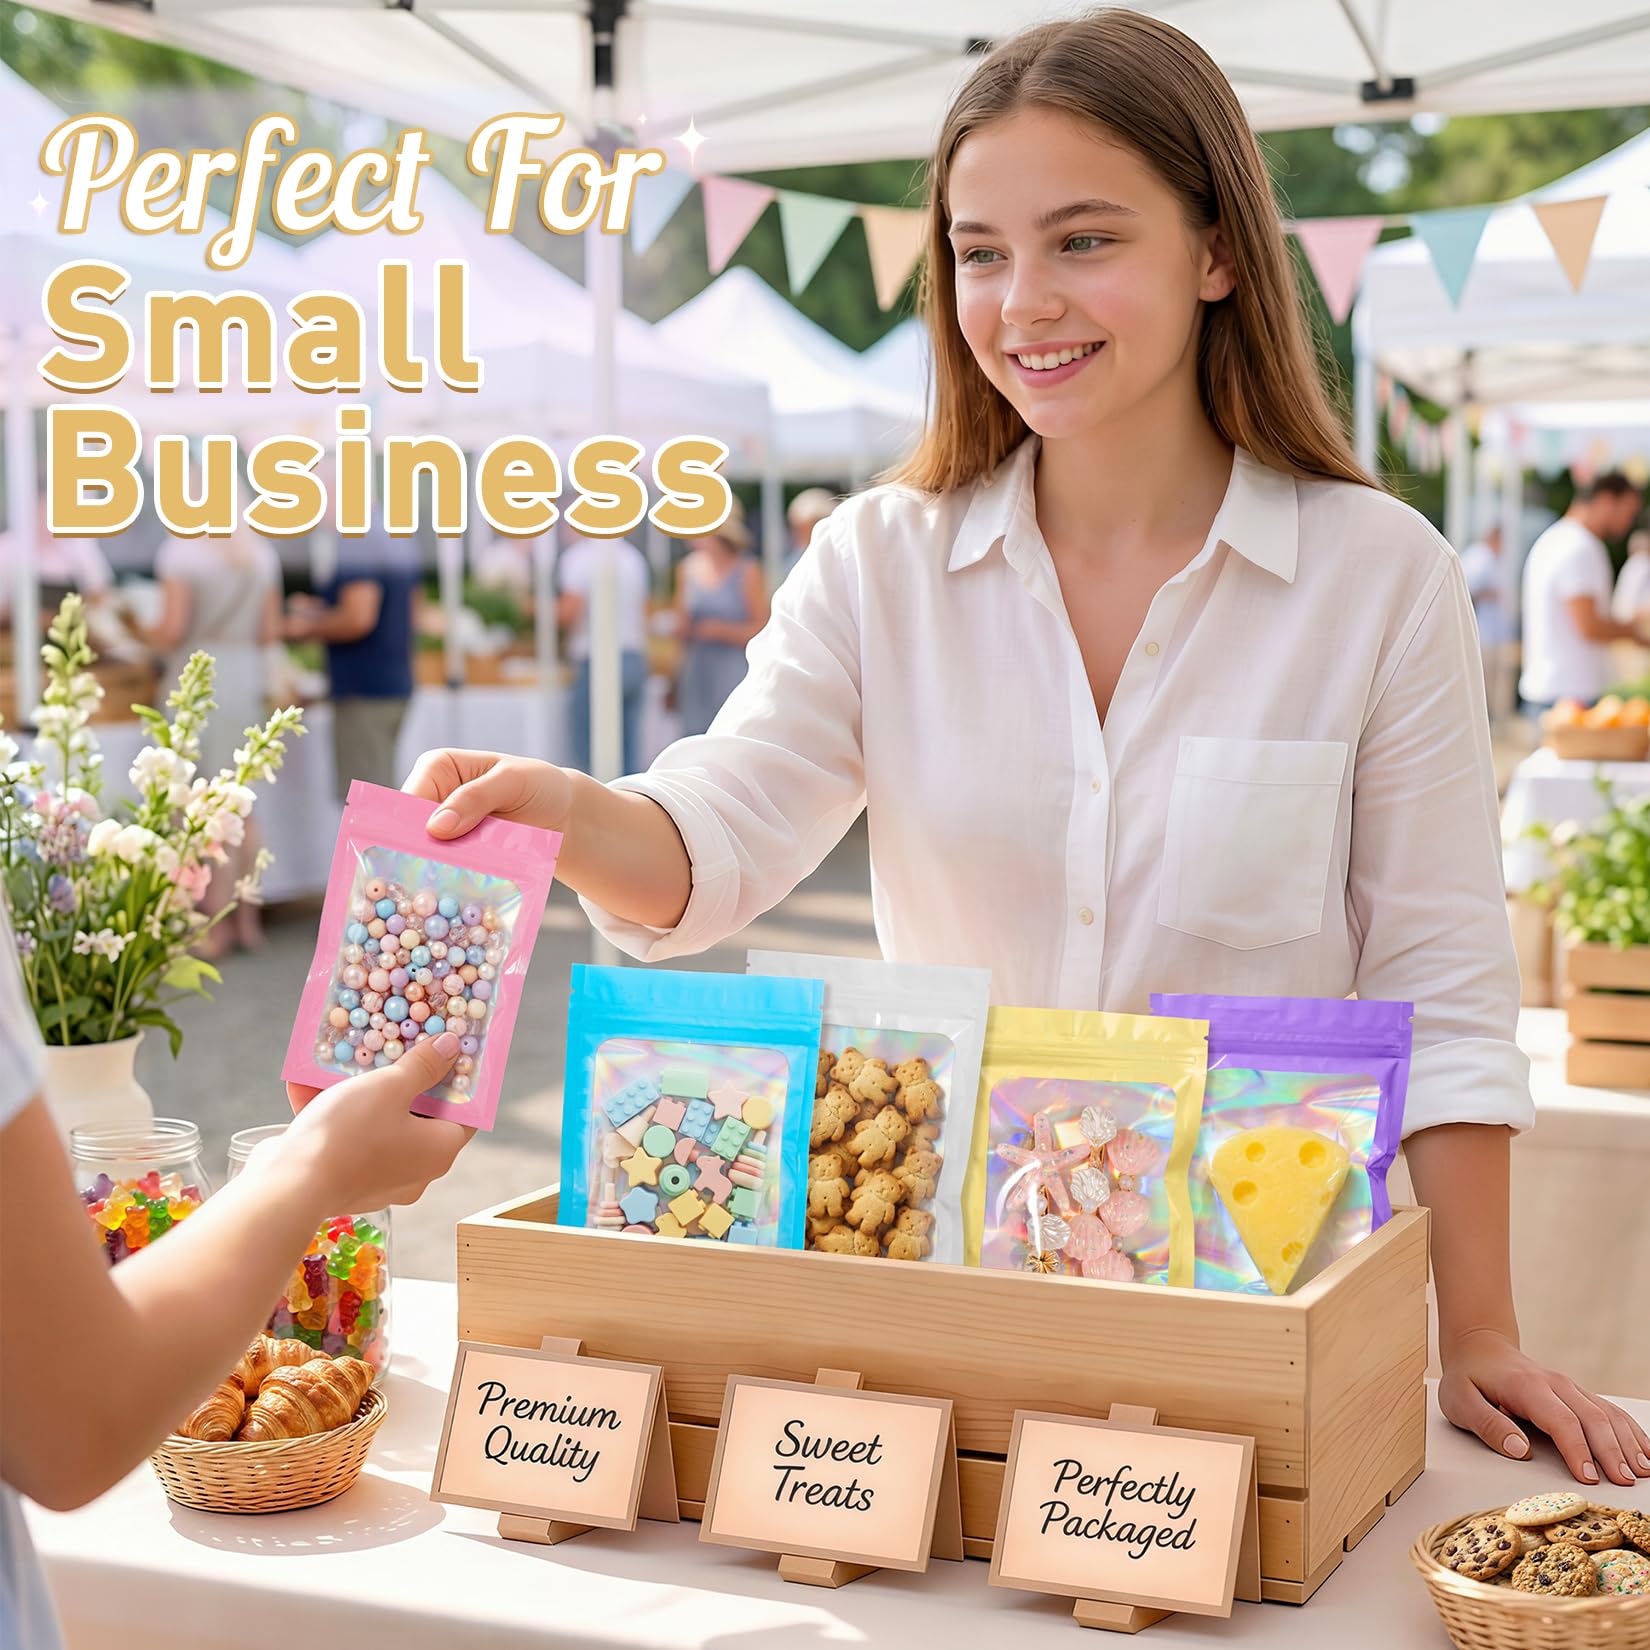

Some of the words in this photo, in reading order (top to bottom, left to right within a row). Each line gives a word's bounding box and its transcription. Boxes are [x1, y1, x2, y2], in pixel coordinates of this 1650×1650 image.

[477, 1381, 622, 1430] Premium
[484, 1425, 601, 1483] Quality
[775, 1419, 883, 1465] Sweet
[773, 1464, 875, 1512] Treats
[1053, 1458, 1197, 1520] Perfectly
[1040, 1500, 1198, 1559] Packaged
